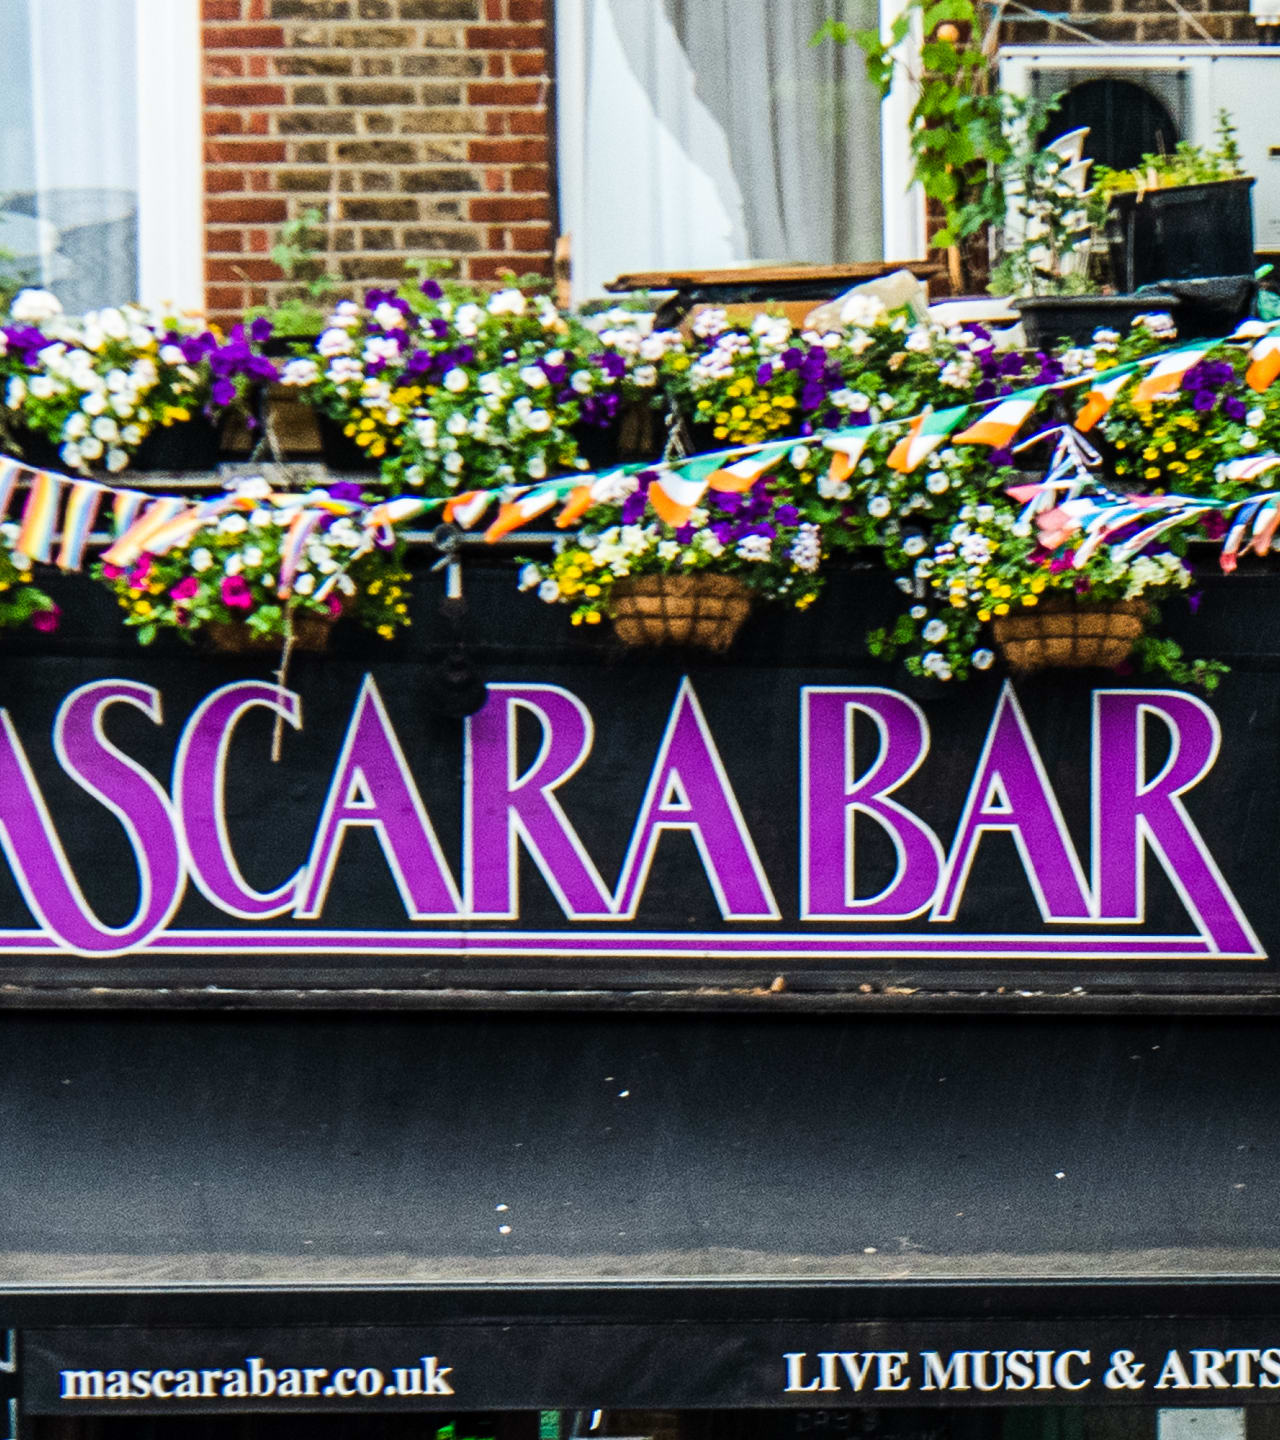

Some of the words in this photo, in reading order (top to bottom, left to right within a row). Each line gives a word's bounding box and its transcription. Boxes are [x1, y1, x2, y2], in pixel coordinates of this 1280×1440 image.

[800, 678, 1269, 958] BAR
[60, 1356, 455, 1400] mascarabar.co.uk
[783, 1351, 911, 1393] LIVE
[920, 1350, 1092, 1392] MUSIC
[1103, 1349, 1146, 1391] &
